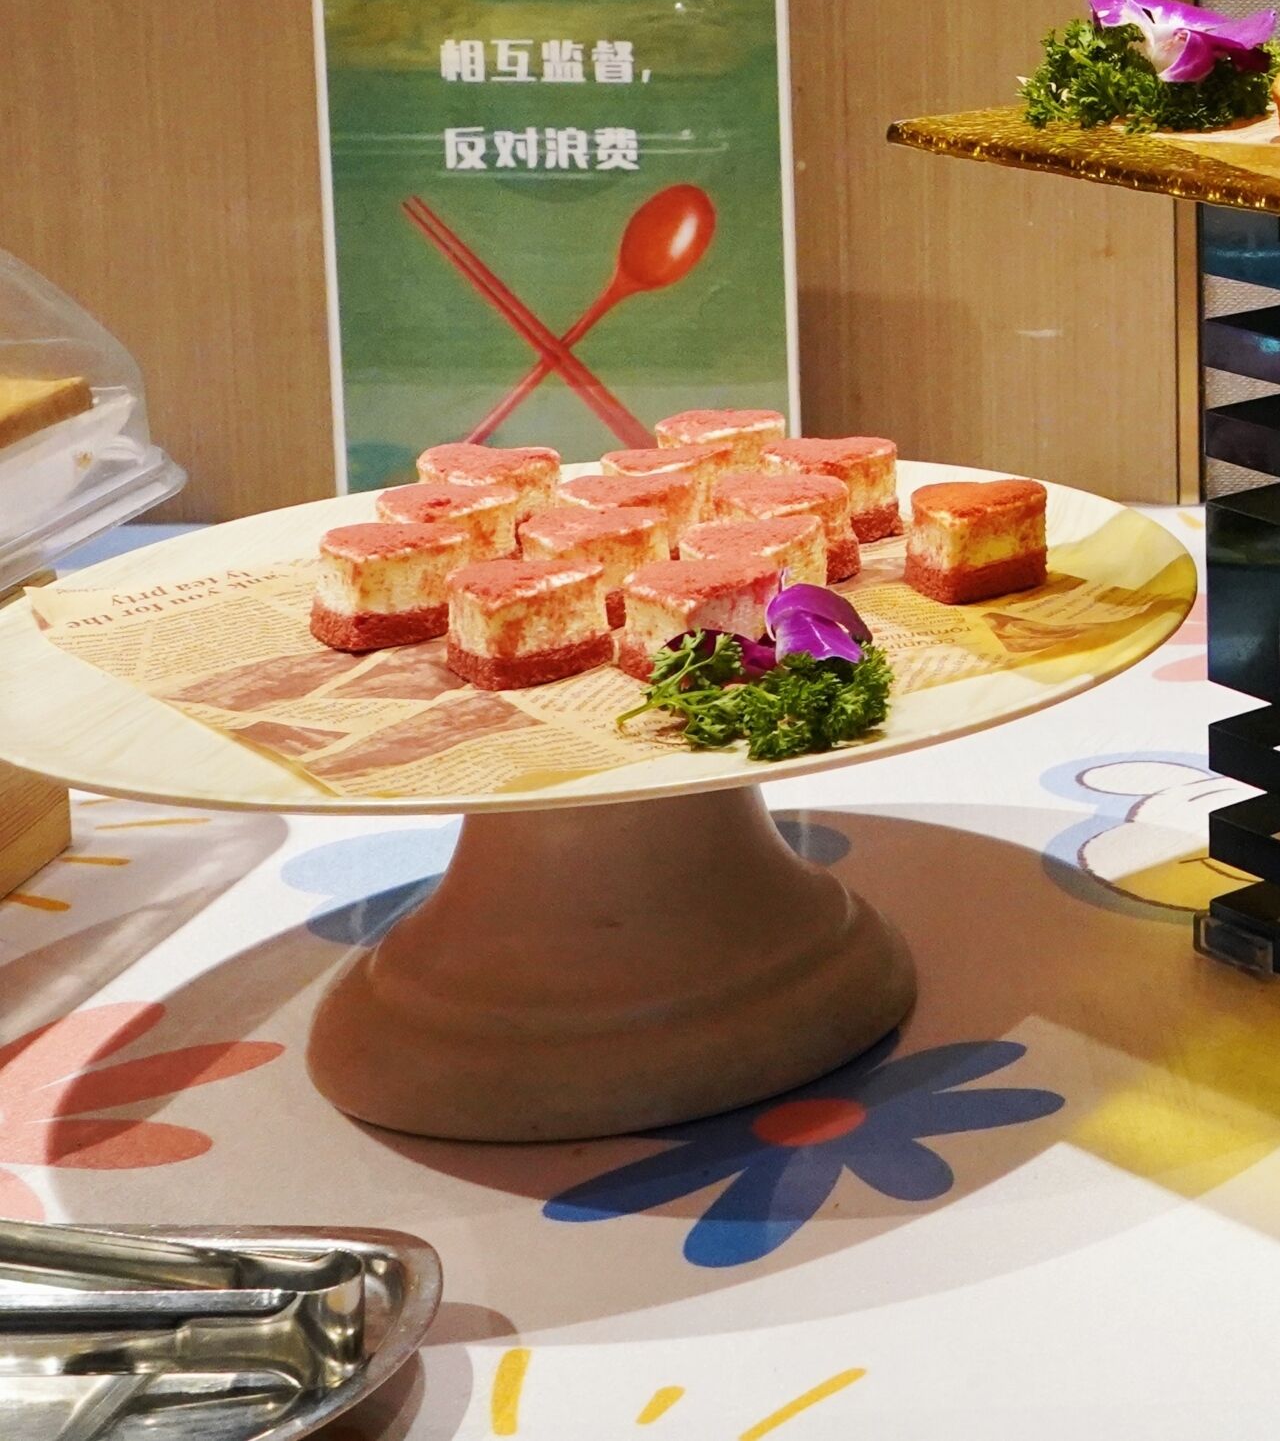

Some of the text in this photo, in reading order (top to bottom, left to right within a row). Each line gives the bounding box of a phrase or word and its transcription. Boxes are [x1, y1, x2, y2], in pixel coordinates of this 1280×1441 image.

[443, 126, 641, 171] 反对浪费
[66, 614, 114, 629] the
